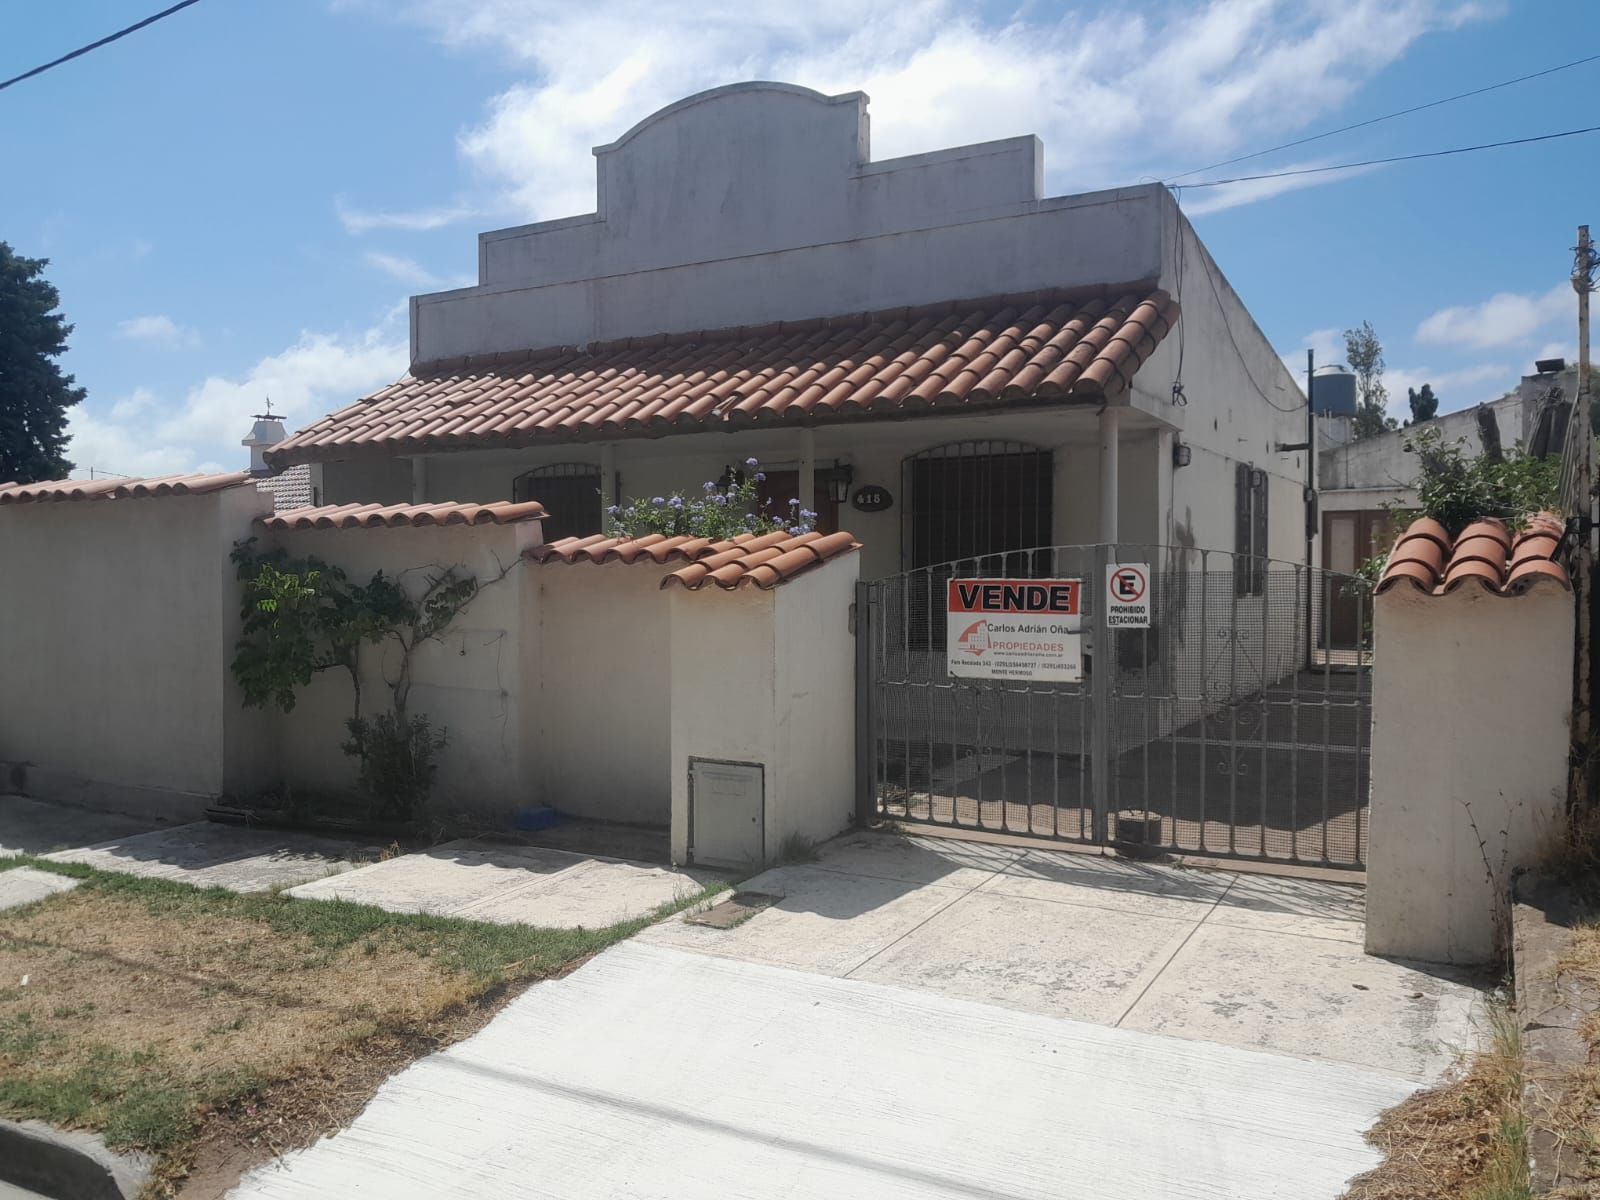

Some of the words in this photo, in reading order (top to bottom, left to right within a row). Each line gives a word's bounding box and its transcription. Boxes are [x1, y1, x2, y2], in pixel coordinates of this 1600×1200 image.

[1120, 575, 1136, 594] E
[958, 584, 1071, 612] VENDE
[1110, 605, 1146, 614] PROHIBIDO
[1108, 616, 1148, 624] ESTACIONAR
[987, 623, 1015, 633] Carlos
[1017, 624, 1047, 633] Adrián
[992, 641, 1064, 652] PROPIEDADES
